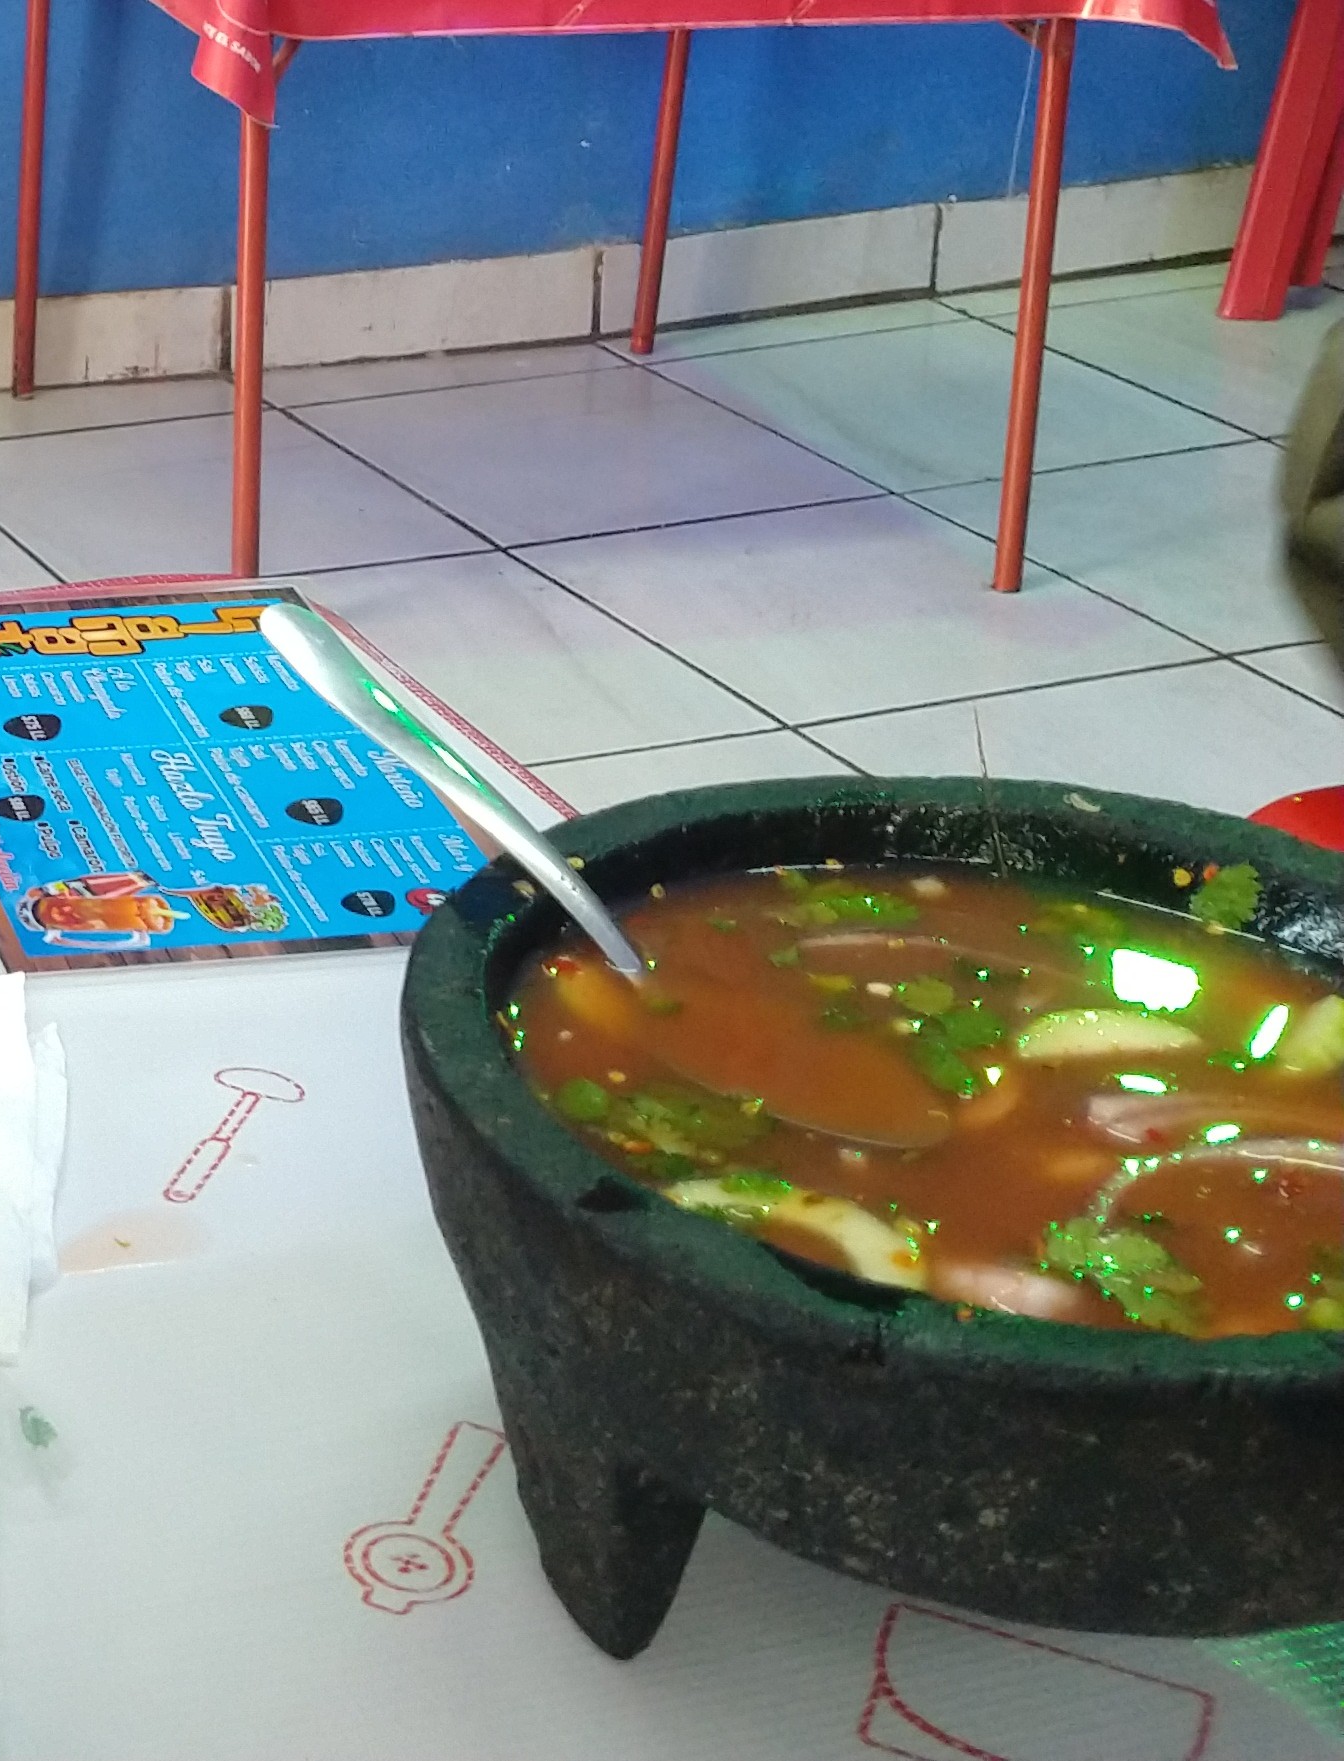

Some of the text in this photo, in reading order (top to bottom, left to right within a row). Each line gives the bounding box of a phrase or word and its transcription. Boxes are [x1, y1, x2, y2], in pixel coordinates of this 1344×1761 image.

[150, 749, 236, 862] Hazlo Tuyo
[37, 827, 61, 859] Pulpo
